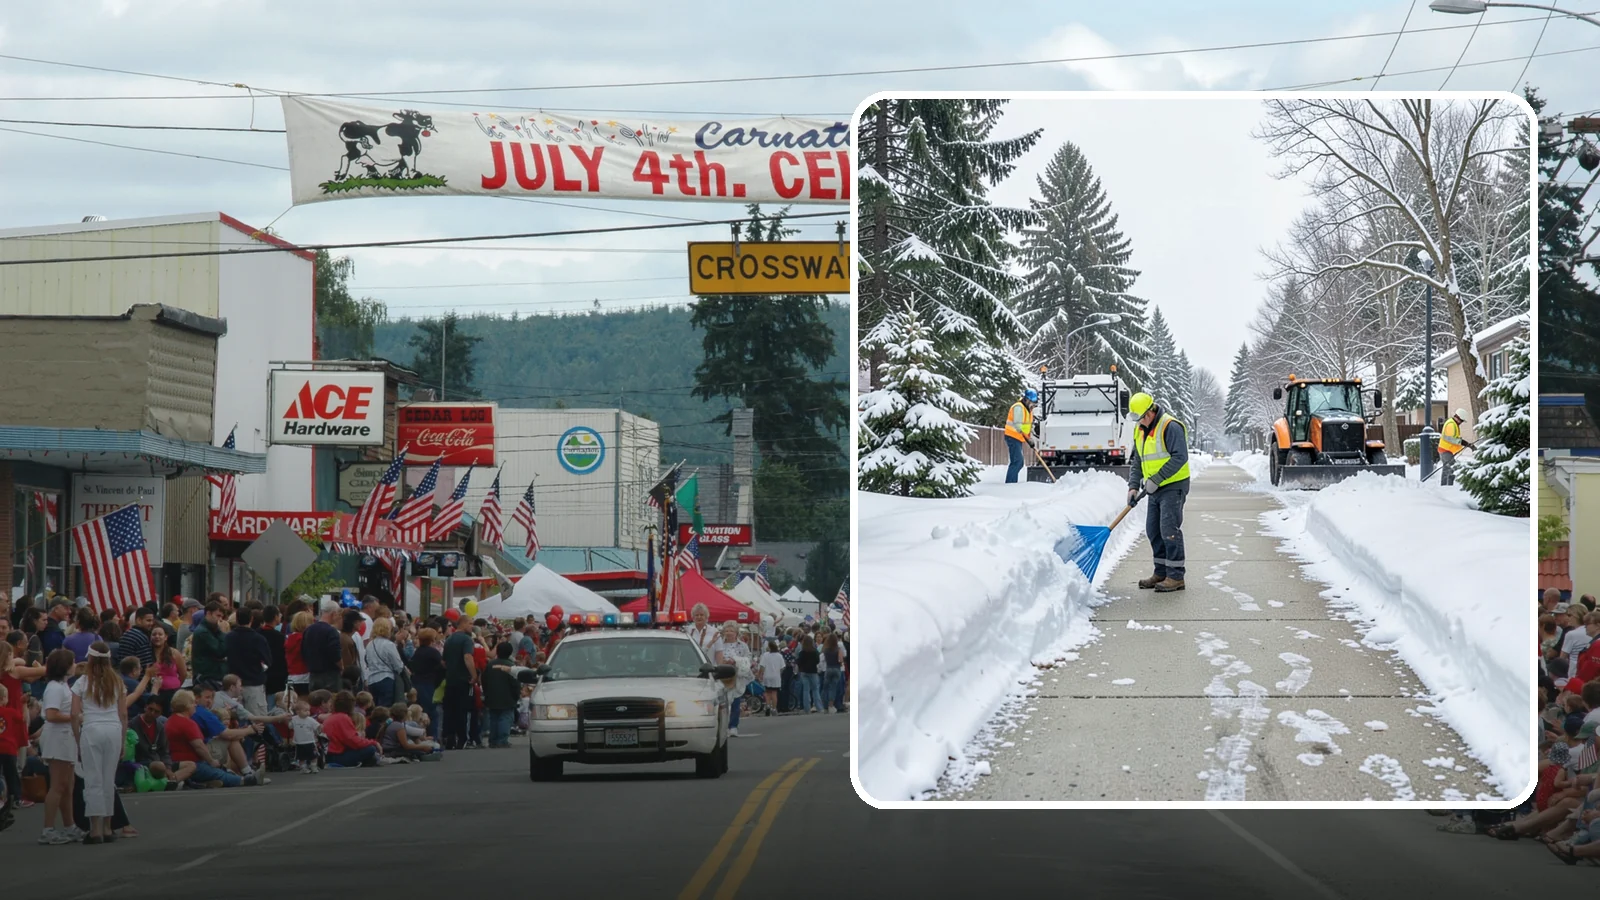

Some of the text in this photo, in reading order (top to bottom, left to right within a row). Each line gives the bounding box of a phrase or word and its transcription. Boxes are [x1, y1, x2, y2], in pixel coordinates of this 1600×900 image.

[694, 121, 850, 150] Carnat
[481, 141, 605, 192] JULY
[632, 150, 746, 197] 4th.
[696, 254, 850, 280] CROSSWA
[282, 380, 373, 420] ACE
[405, 409, 485, 422] CEDAR LOG
[283, 421, 370, 436] Hardware
[416, 428, 477, 447] Coca-Cola
[95, 485, 124, 495] Vincent
[126, 486, 137, 495] de
[137, 486, 155, 495] Paul
[688, 526, 742, 535] CRNATION
[699, 535, 730, 543] GLASS
